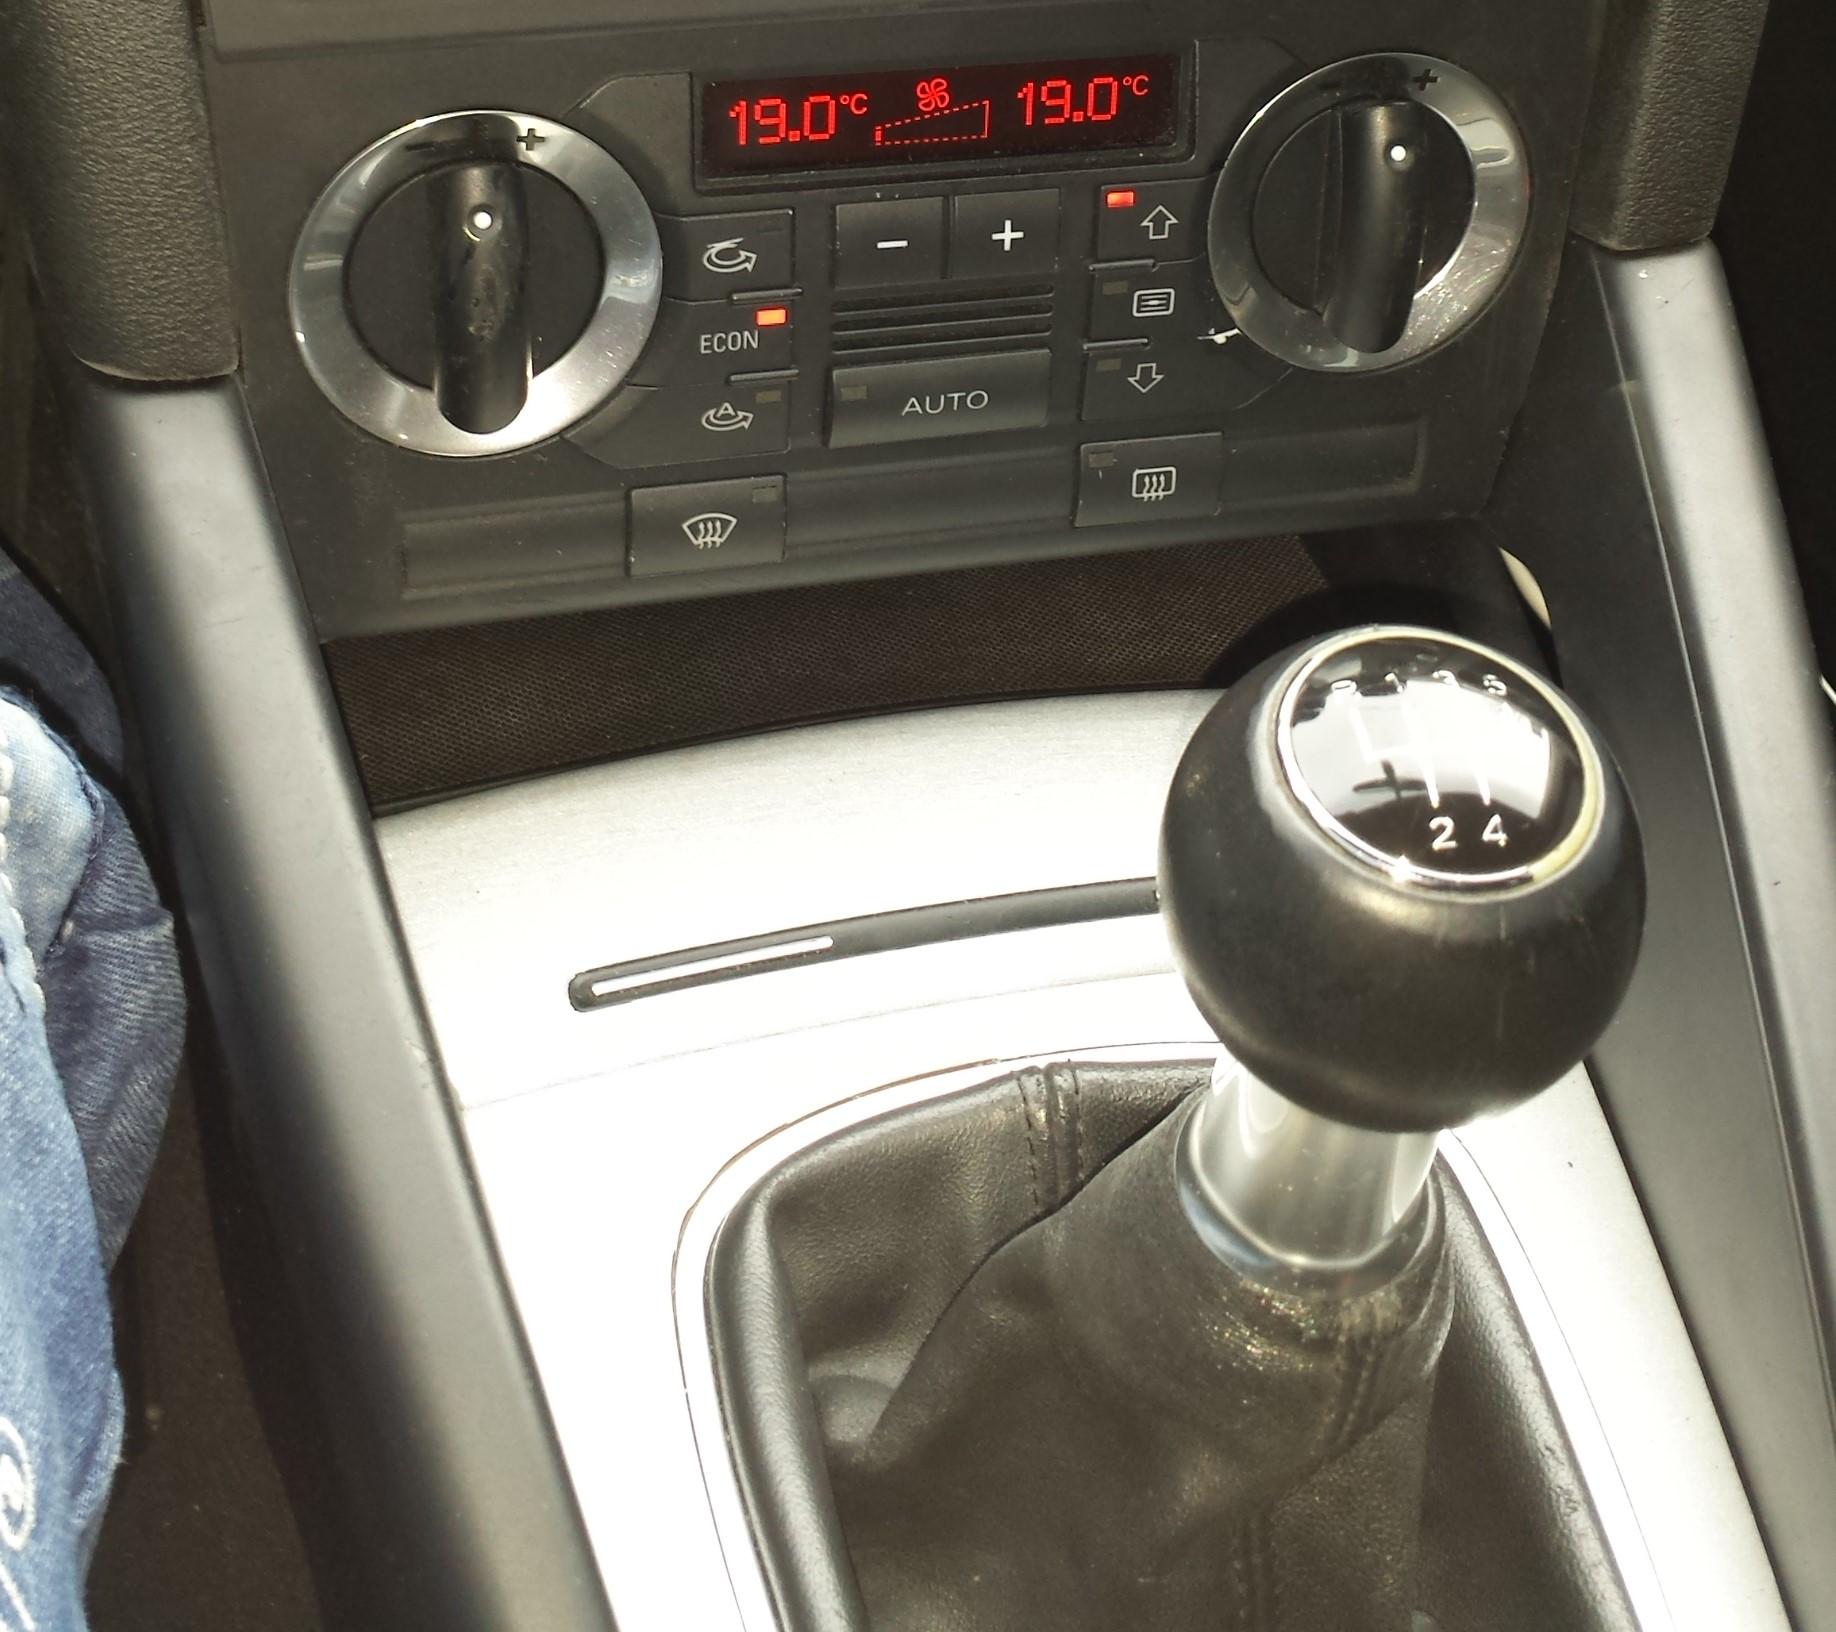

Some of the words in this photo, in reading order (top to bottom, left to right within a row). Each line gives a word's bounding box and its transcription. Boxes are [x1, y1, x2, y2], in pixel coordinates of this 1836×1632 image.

[701, 329, 759, 355] ECON
[901, 389, 990, 417] AUTO
[1429, 816, 1457, 851] 2
[1481, 814, 1509, 847] 4
